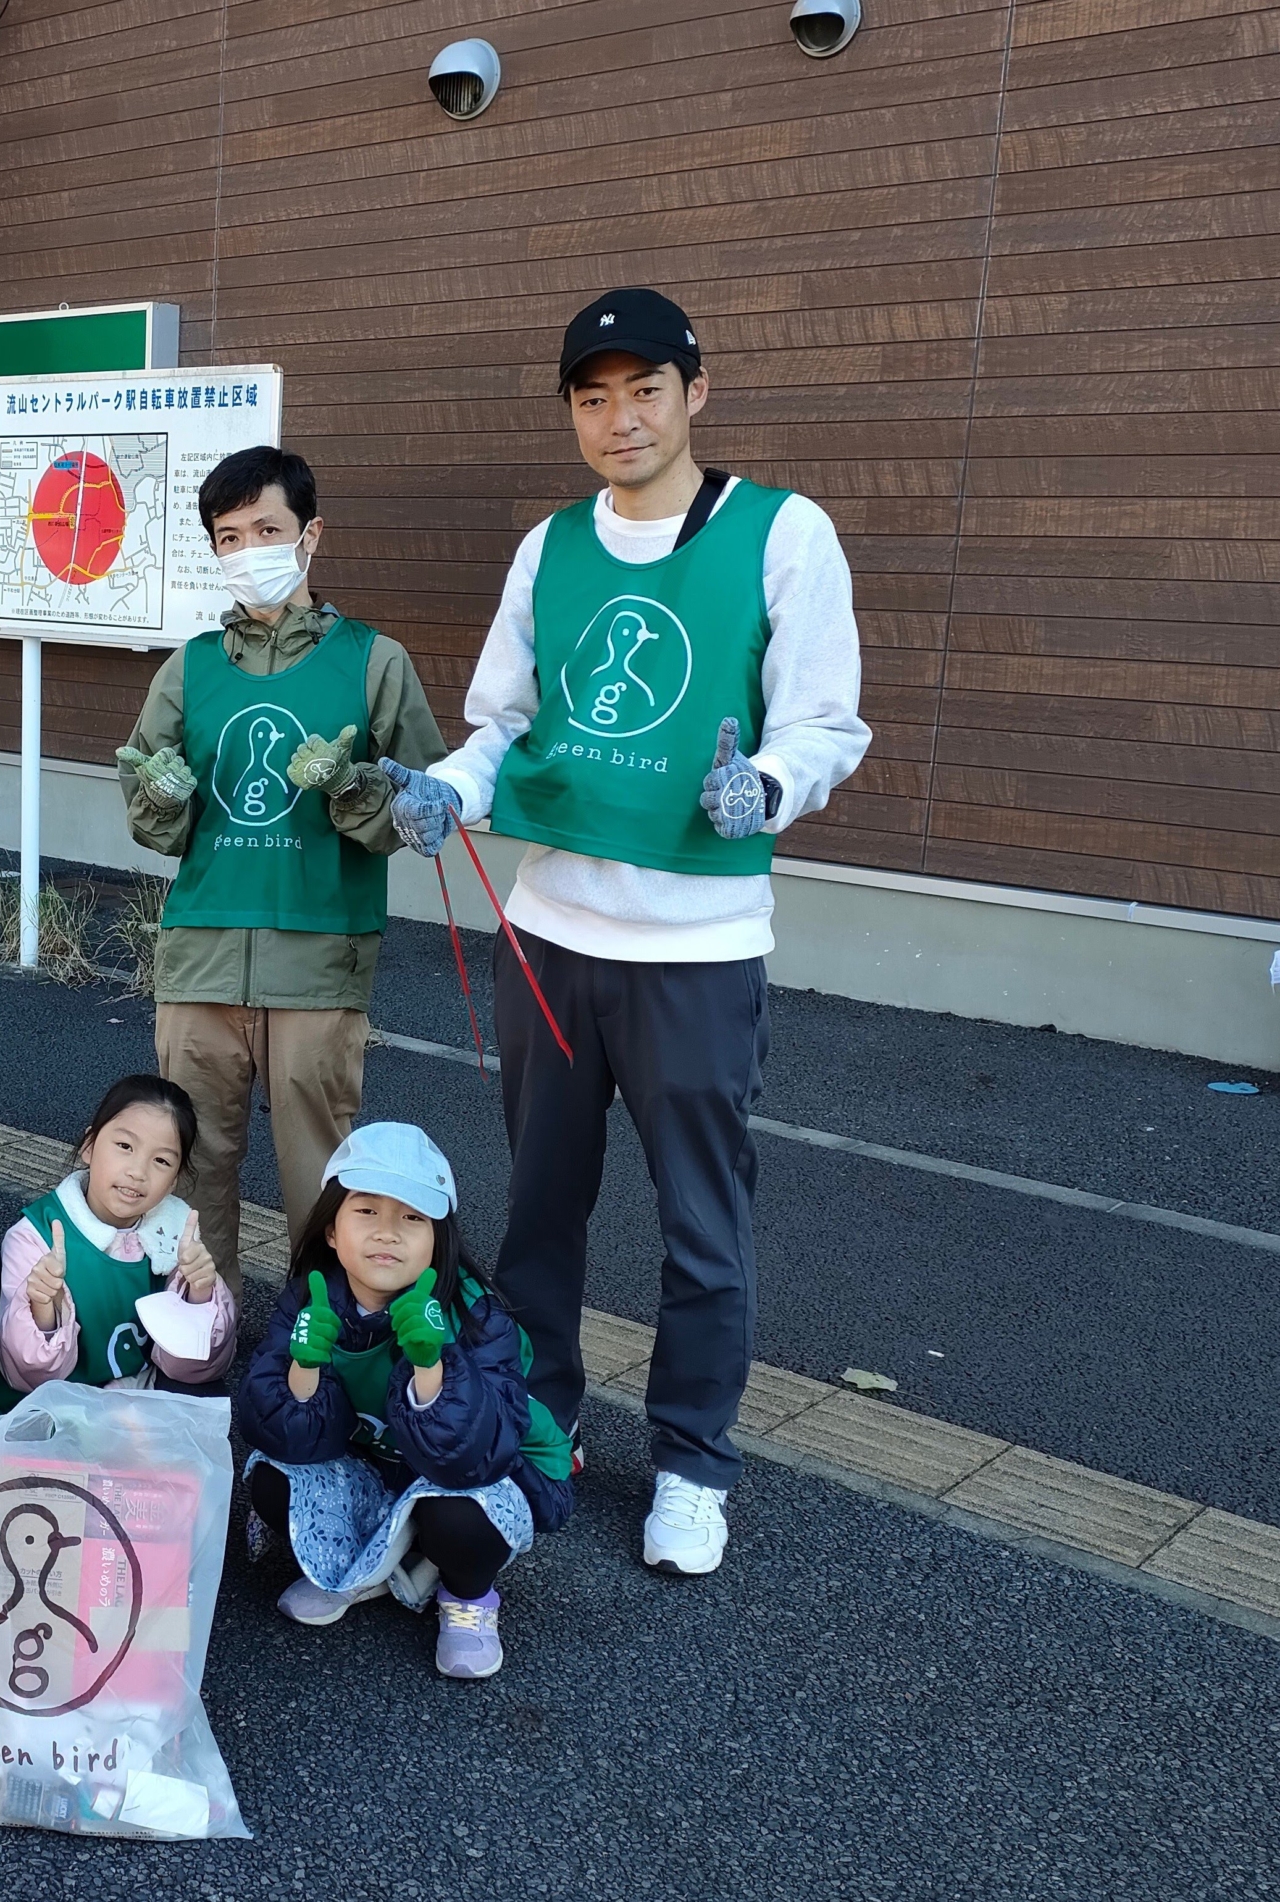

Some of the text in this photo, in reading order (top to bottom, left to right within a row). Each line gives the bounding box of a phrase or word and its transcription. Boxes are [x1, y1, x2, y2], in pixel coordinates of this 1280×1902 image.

[6, 383, 259, 415] 流山セントラルパーク駅自転車放置禁止区域
[610, 747, 669, 774] bird
[264, 833, 303, 850] bird
[298, 1311, 311, 1345] SAVE
[116, 1558, 127, 1583] THE
[52, 1738, 119, 1773] bird
